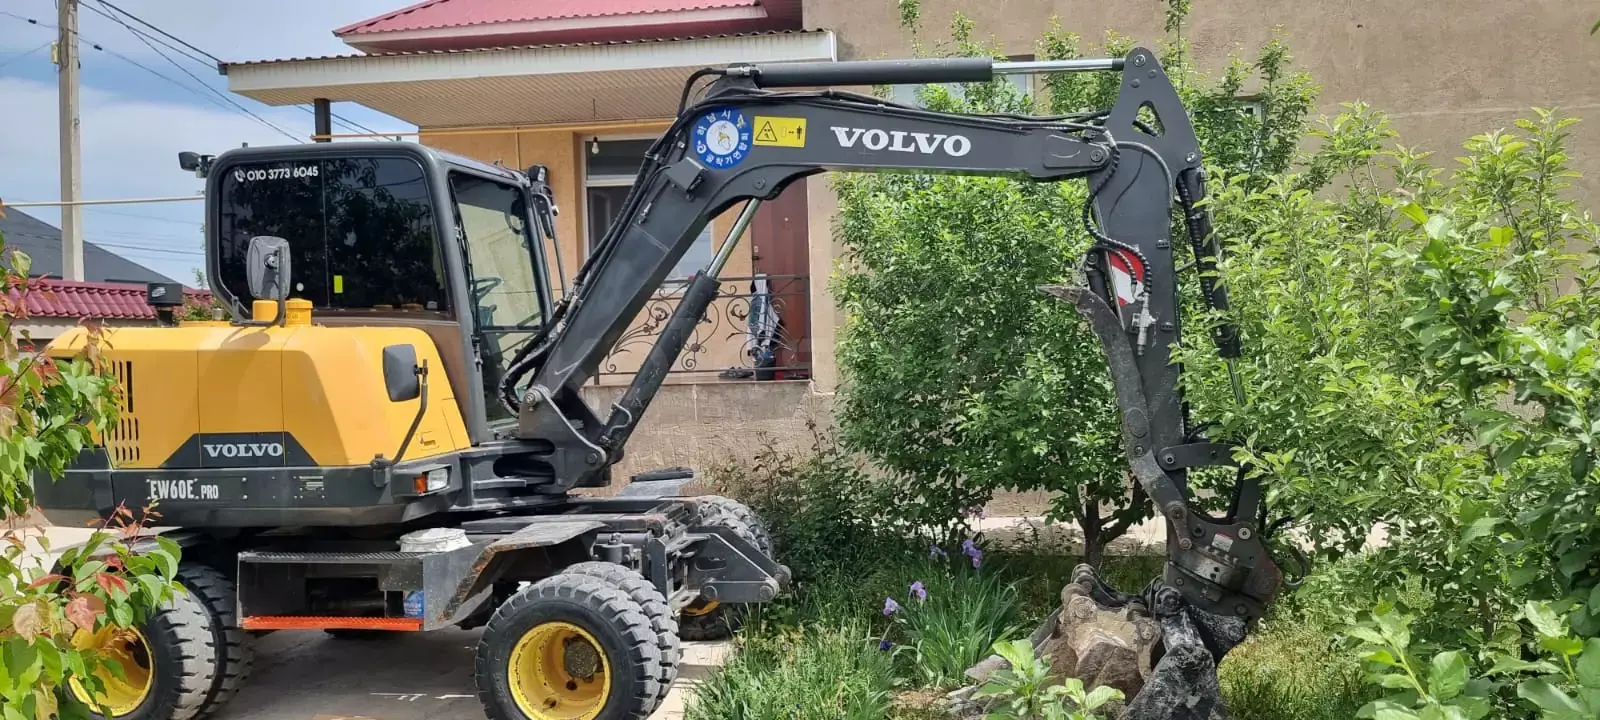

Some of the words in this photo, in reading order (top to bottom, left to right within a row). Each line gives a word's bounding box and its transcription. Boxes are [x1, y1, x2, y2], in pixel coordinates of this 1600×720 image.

[697, 110, 731, 136] 하남시
[830, 126, 971, 157] VOLVO
[247, 170, 266, 181] 010
[268, 168, 290, 180] 3773
[293, 166, 318, 178] 6045
[204, 443, 283, 457] VOLVO
[150, 480, 195, 499] EW60E
[201, 485, 219, 499] PRO
